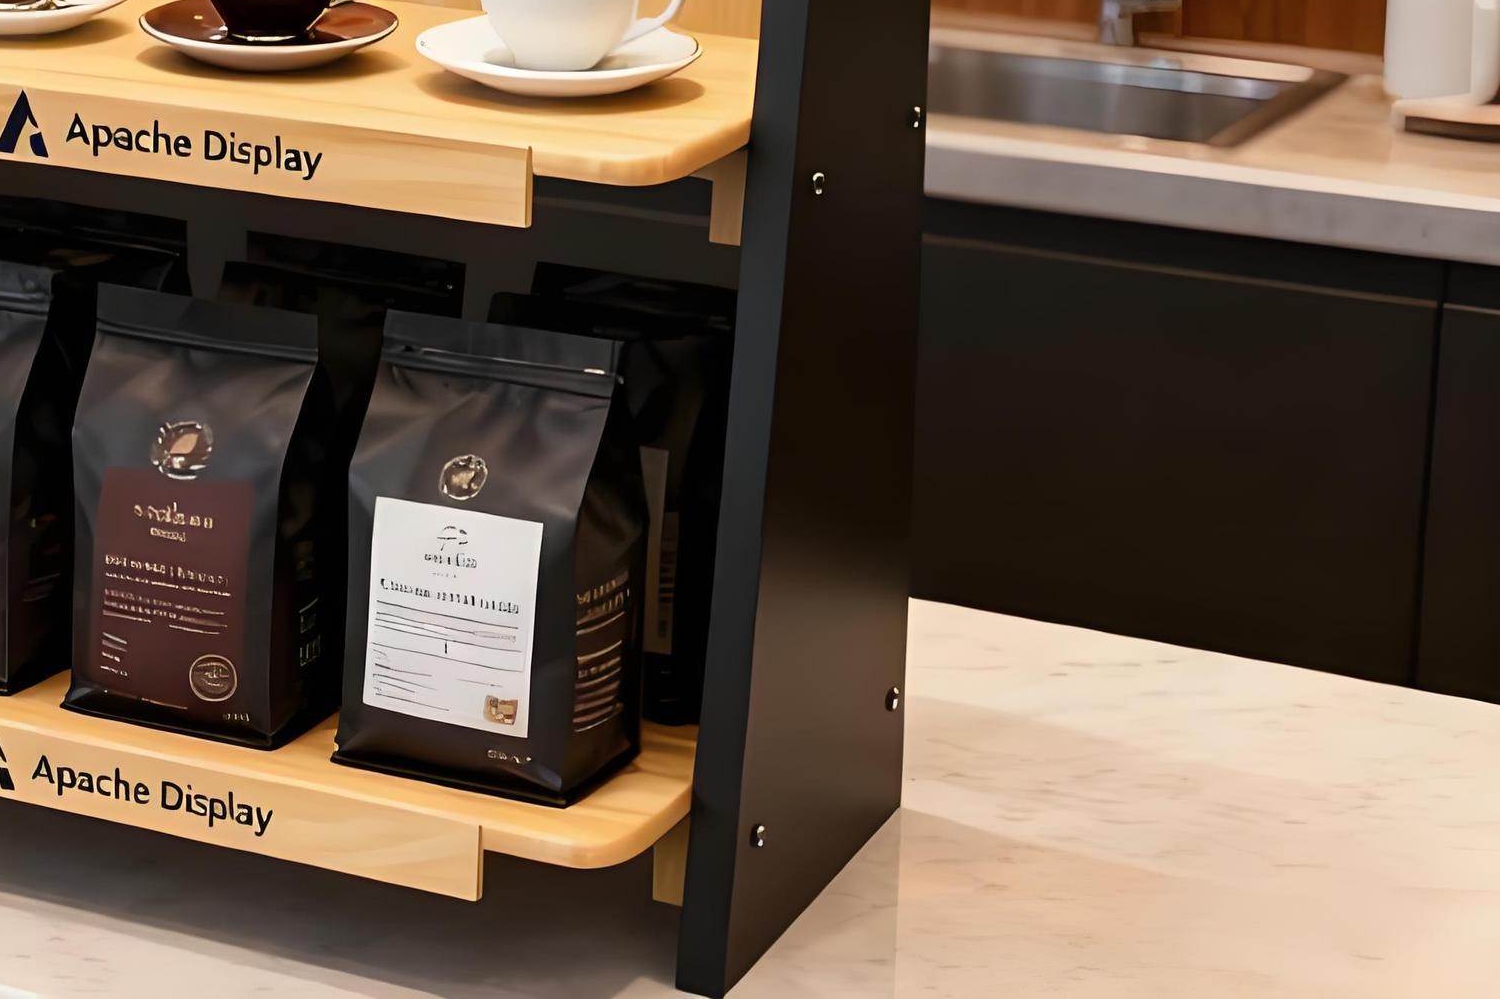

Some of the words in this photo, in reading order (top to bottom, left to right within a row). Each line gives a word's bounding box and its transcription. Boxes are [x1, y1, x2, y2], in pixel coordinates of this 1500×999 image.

[65, 112, 192, 158] Apache
[204, 129, 323, 181] Display
[31, 754, 150, 805] Apache
[160, 780, 273, 837] Display
